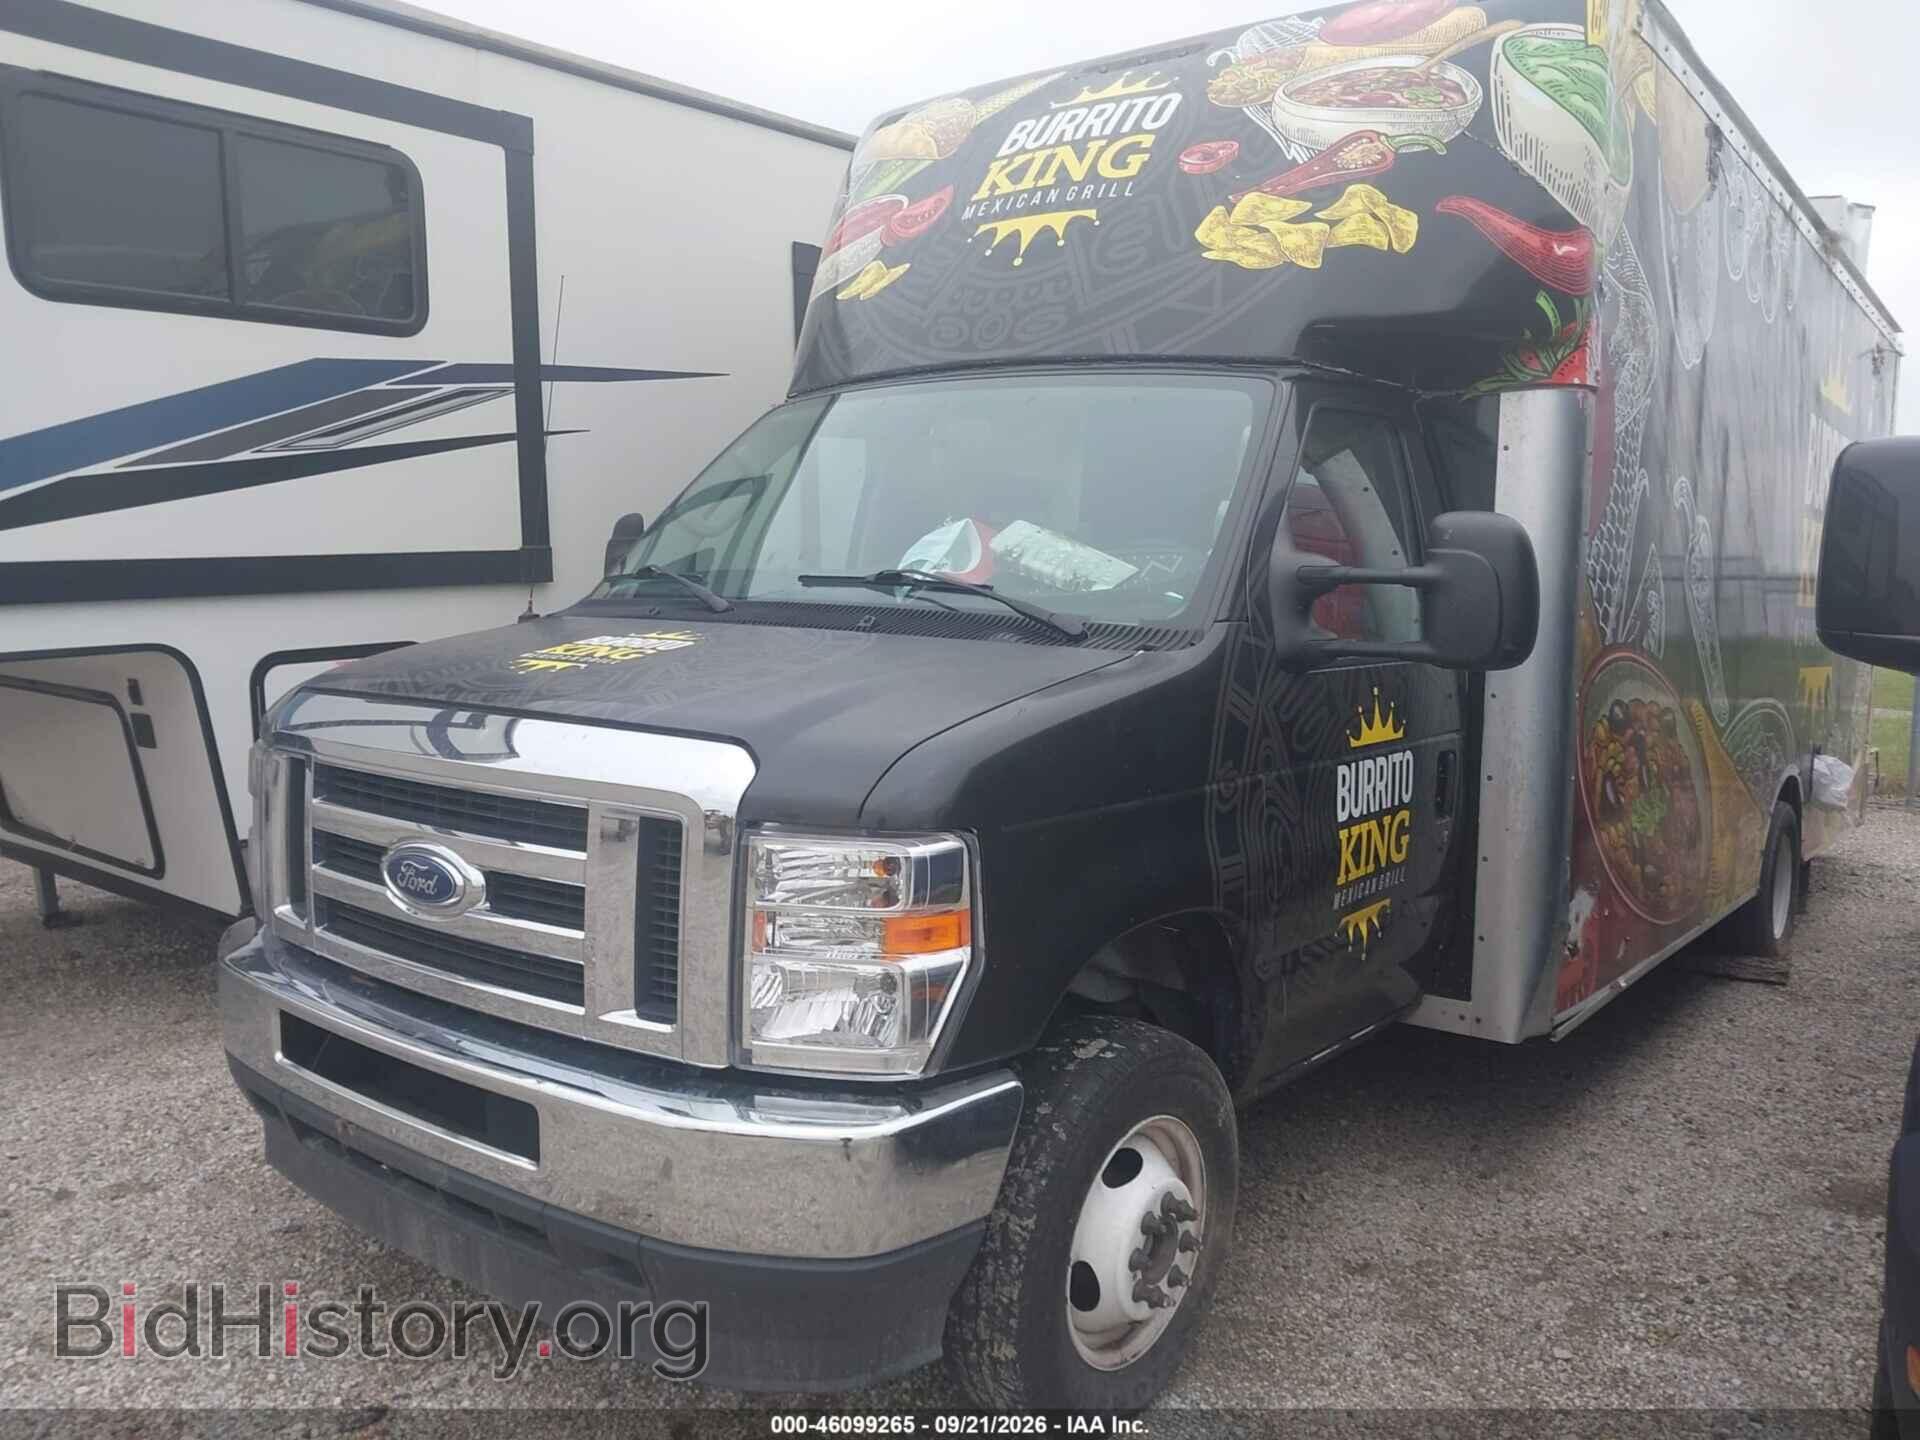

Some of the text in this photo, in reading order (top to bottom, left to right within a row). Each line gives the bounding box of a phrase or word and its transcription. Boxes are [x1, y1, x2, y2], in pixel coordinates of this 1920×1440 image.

[995, 92, 1183, 158] BURRITO
[971, 134, 1155, 201] KING
[961, 181, 1134, 221] MEXICAN GRILL
[1337, 750, 1413, 823] BURRITO
[397, 860, 439, 895] Ford
[1336, 810, 1410, 886] KING
